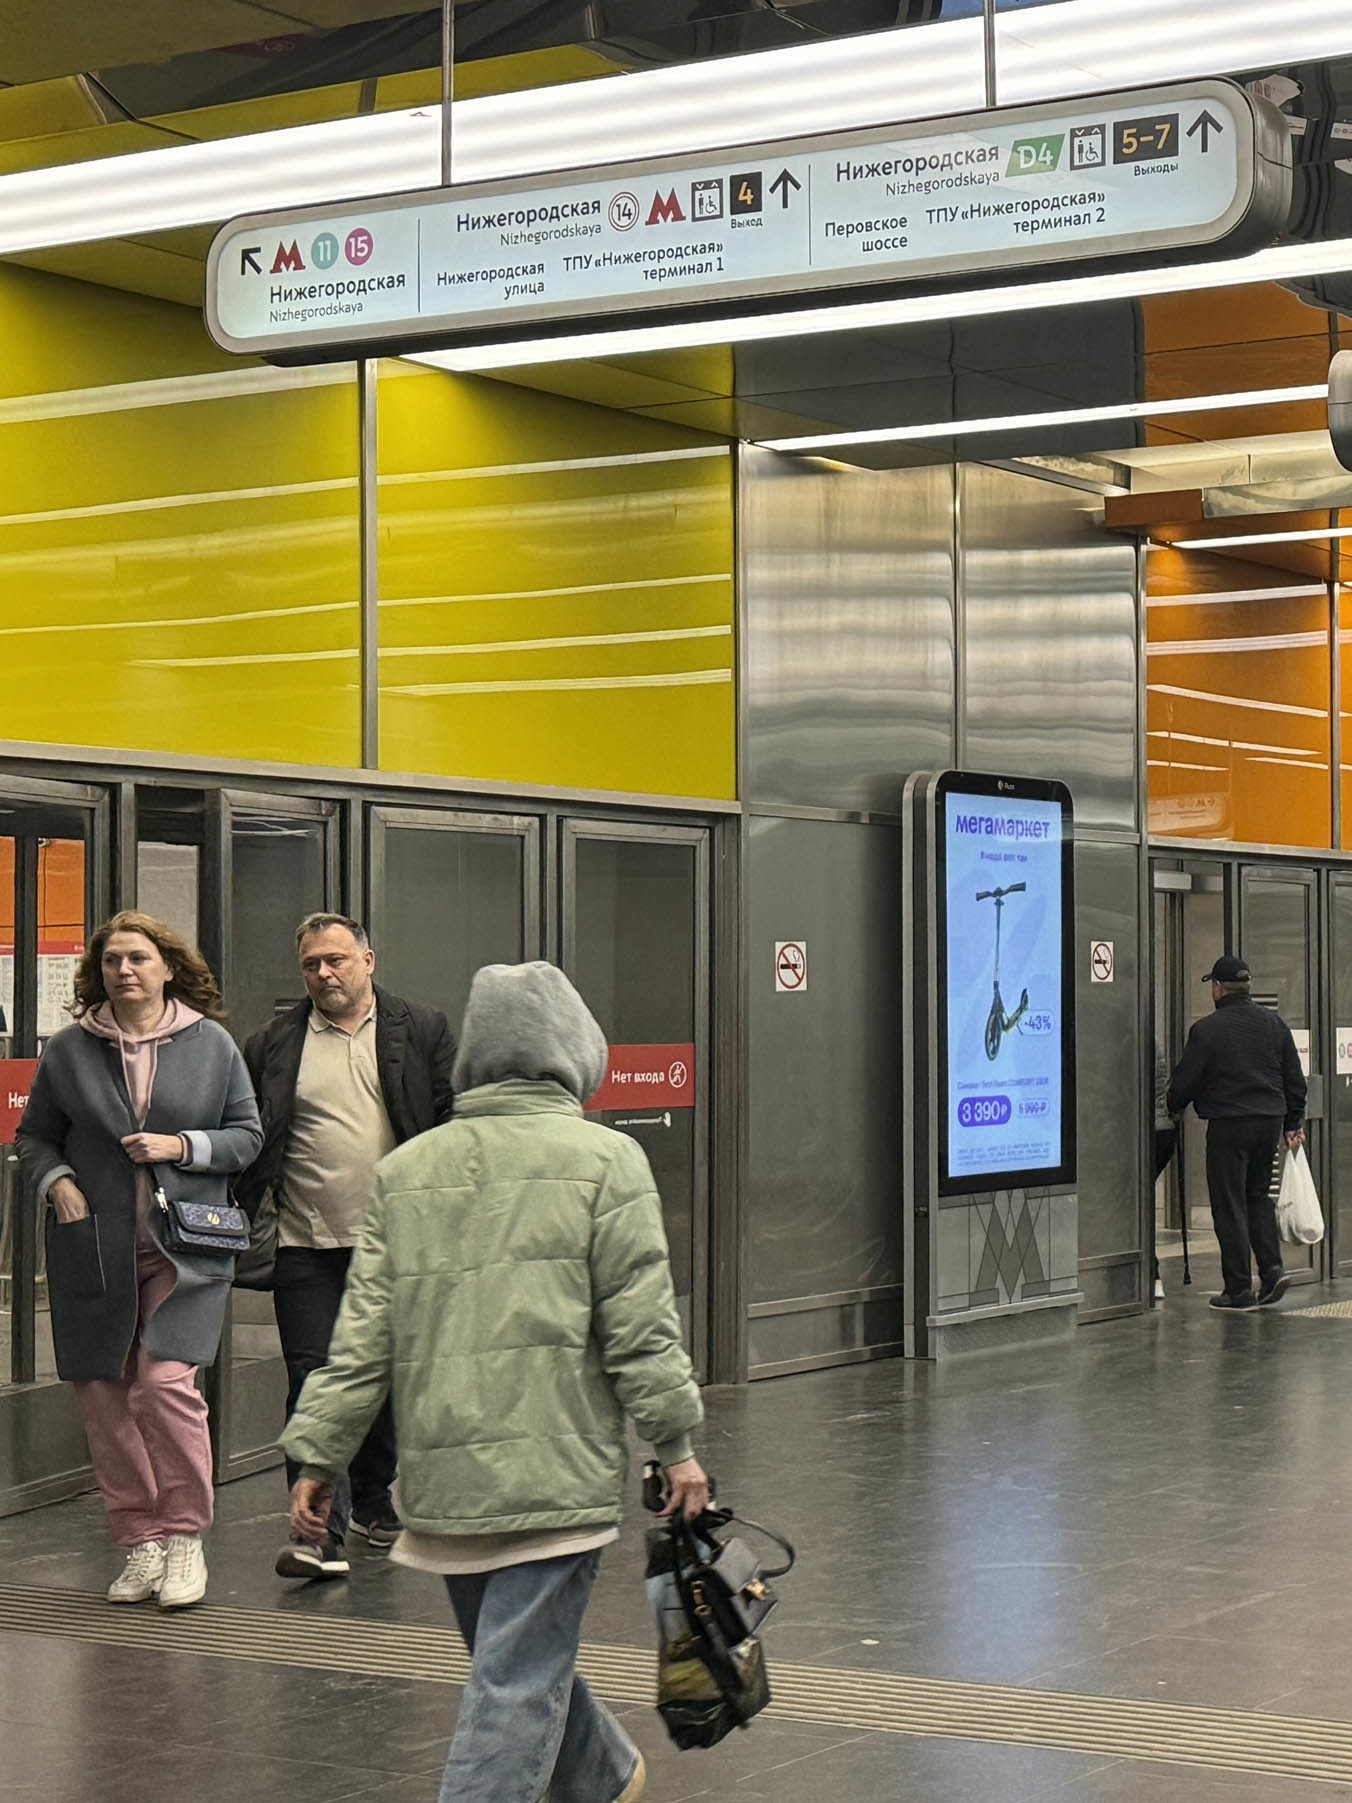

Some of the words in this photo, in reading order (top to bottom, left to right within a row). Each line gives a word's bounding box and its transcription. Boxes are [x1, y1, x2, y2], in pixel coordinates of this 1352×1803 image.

[836, 145, 999, 183] Нижегородская
[1016, 143, 1054, 170] D4
[1133, 162, 1180, 177] Выходы
[885, 171, 1000, 198] Nizhegorodskaya
[456, 200, 601, 232] Нижегородская
[615, 203, 632, 221] 14
[738, 181, 754, 205] 4
[926, 206, 959, 226] ТПУ
[961, 191, 1106, 221] «Нижегородская»
[730, 217, 763, 229] Выход
[824, 214, 908, 239] Перовское
[1013, 211, 1092, 235] терминал
[1096, 207, 1106, 224] 2
[500, 222, 602, 247] Nizhegorodskaya
[861, 234, 908, 253] шоссе
[317, 240, 332, 262] 11
[349, 235, 369, 259] 15
[562, 254, 593, 272] ТПУ
[594, 242, 724, 269] «Нижегородская»
[436, 263, 545, 287] Нижегородская
[642, 260, 713, 282] терминал
[715, 257, 725, 272] 1
[269, 273, 406, 304] Нижегородская
[503, 281, 545, 300] улица
[269, 300, 364, 323] Nizhegorodskaya
[955, 814, 1051, 841] мегамаркет
[1024, 1016, 1051, 1031] -43%
[611, 1070, 632, 1084] Нет
[634, 1071, 665, 1085] входа
